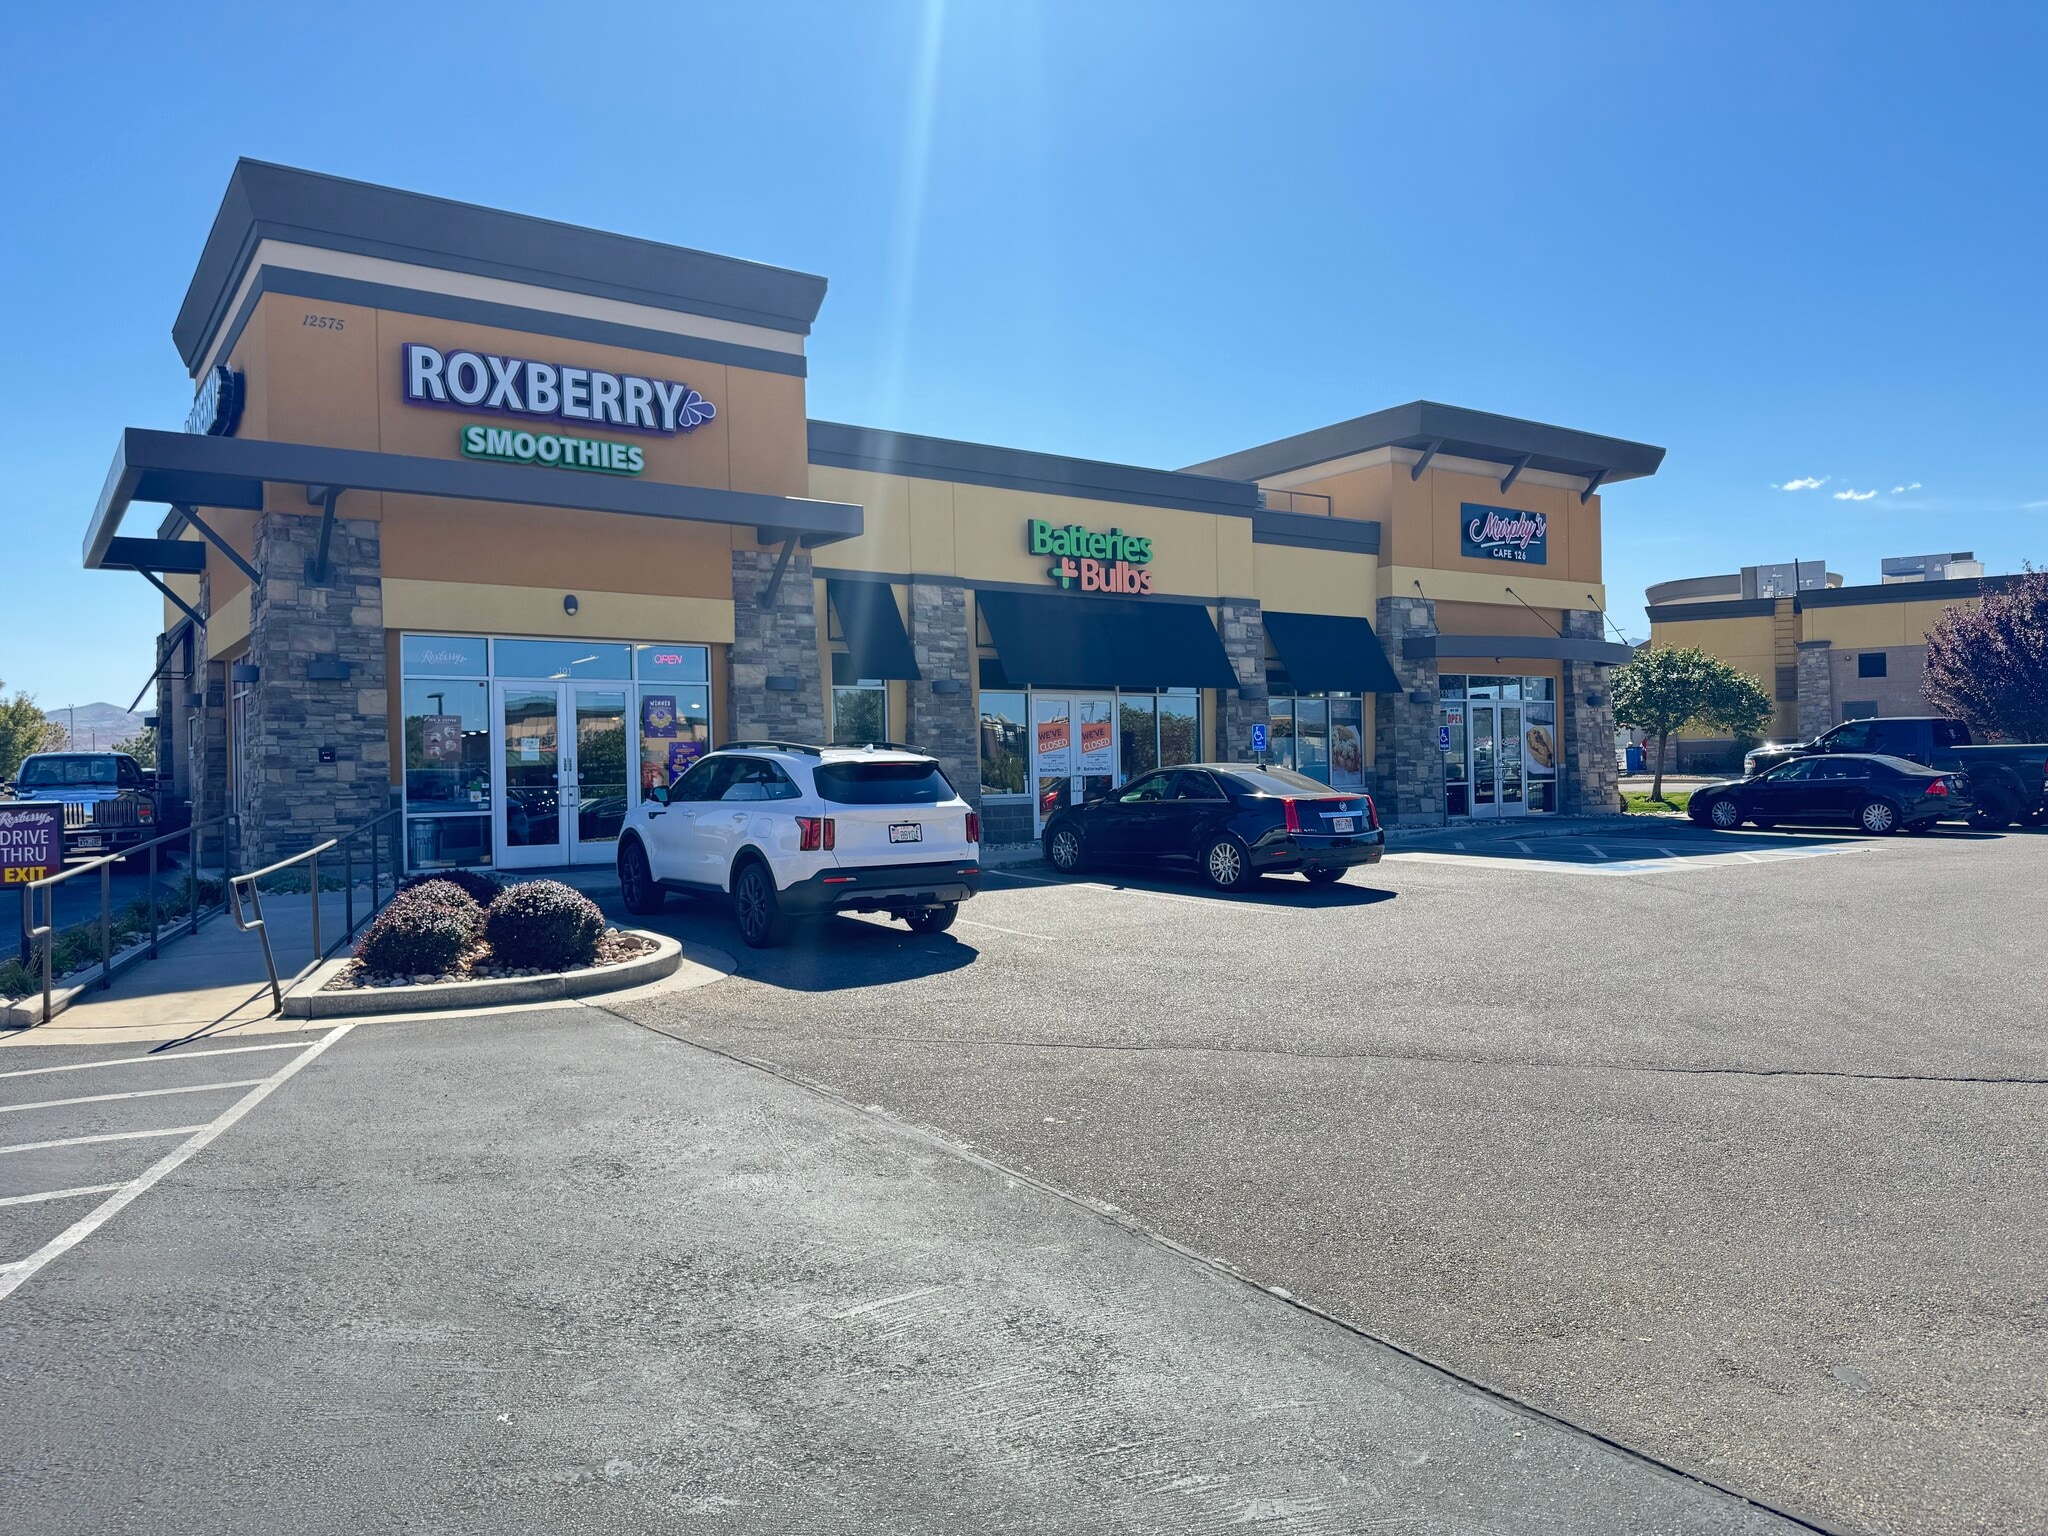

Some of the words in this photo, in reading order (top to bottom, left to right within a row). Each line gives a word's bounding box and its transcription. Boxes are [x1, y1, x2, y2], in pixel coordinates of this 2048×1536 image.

[303, 315, 345, 331] 12575
[408, 345, 687, 431] ROXBERRY
[465, 426, 645, 472] SMOOTHIES
[1469, 511, 1547, 550] Murphy's
[1030, 519, 1153, 563] Batteries
[1493, 548, 1513, 559] CAFE
[1514, 550, 1527, 561] 126
[1080, 558, 1153, 595] Bulbs
[653, 654, 683, 665] OPEN
[1038, 729, 1063, 741] WE'VE
[1082, 729, 1105, 740] WE'VE
[1040, 738, 1068, 752] CLOSED
[1083, 738, 1110, 751] CLOSED
[0, 829, 49, 846] DRIVE
[0, 846, 47, 863] THRU
[4, 866, 47, 883] EXIT
